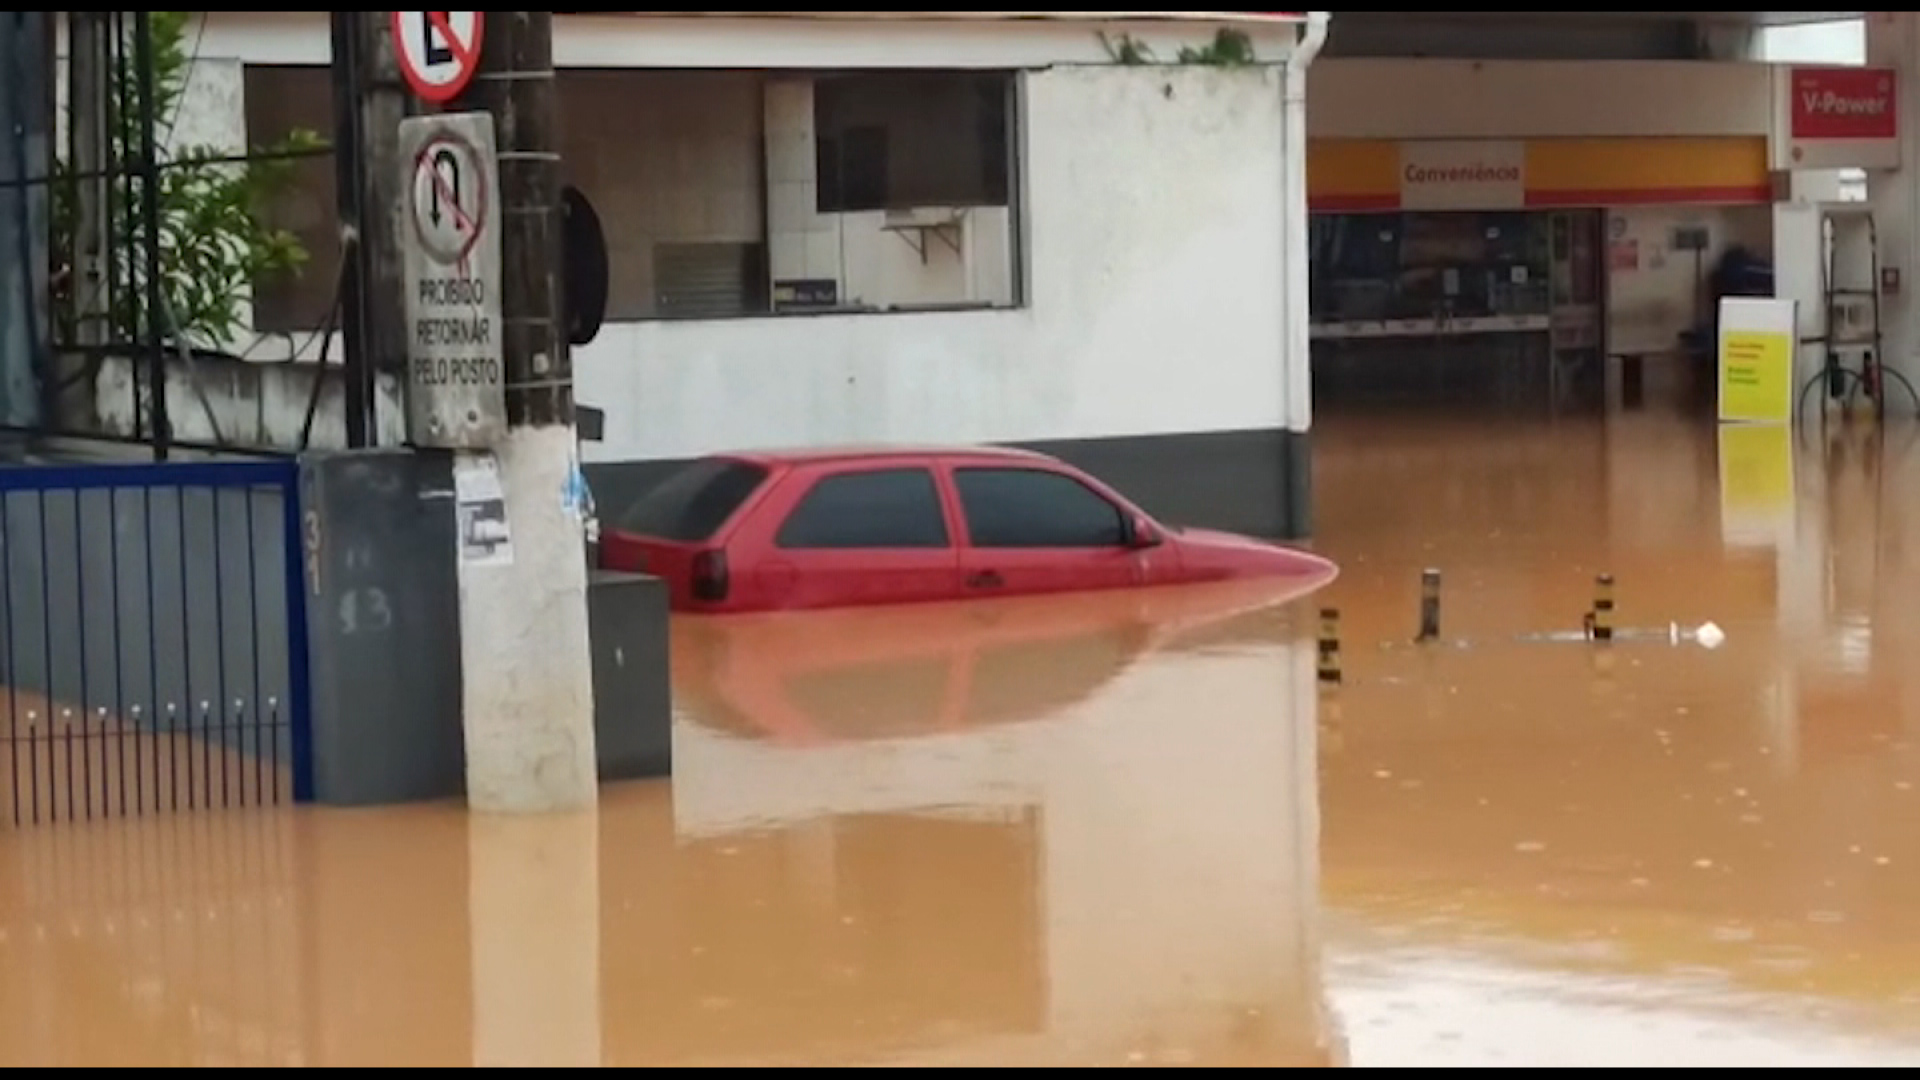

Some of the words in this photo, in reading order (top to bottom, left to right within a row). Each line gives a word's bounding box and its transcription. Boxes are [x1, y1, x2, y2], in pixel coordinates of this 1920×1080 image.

[1802, 90, 1887, 115] V-Power
[1404, 161, 1520, 183] Conveniência
[418, 279, 484, 306] PROIBIDO
[416, 317, 490, 345] RETORNAR
[413, 358, 448, 386] PELO
[450, 358, 498, 386] POSTO
